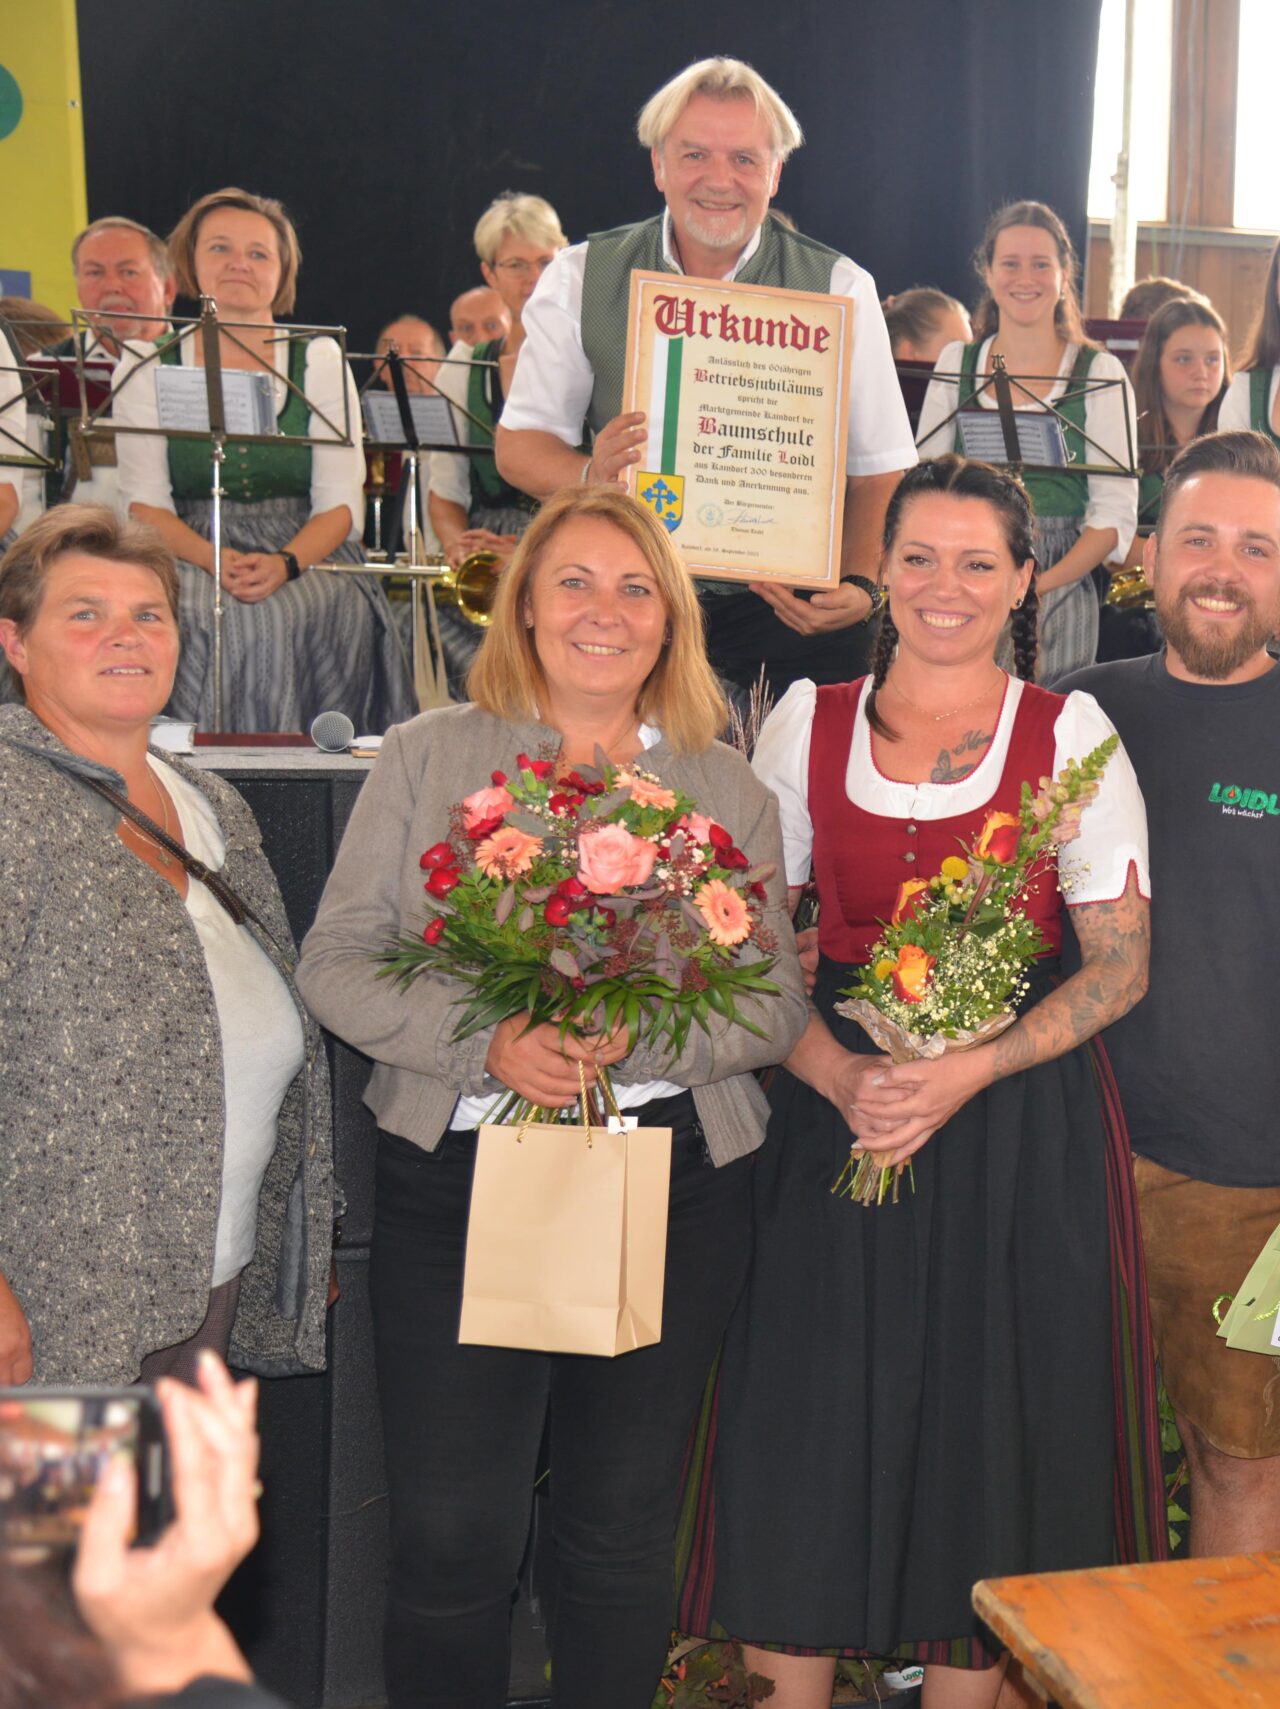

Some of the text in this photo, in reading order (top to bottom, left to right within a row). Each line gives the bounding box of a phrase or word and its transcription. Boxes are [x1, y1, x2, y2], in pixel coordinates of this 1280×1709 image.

[653, 294, 831, 353] Urkunde
[708, 355, 751, 369] Anlässlich
[768, 364, 812, 376] 60jährigen
[693, 368, 824, 397] Betriebsjubiläums
[738, 395, 778, 406] spricht die
[699, 404, 761, 418] Marktgemeinde
[802, 417, 814, 425] der
[697, 416, 814, 446] Baumschule
[693, 442, 815, 467] der Familie Loidl
[694, 461, 708, 469] aus
[770, 470, 813, 481] besonderen
[696, 475, 719, 485] Dank
[721, 479, 736, 487] und
[738, 479, 791, 495] Anerkennung
[1208, 783, 1280, 815] LOIDL
